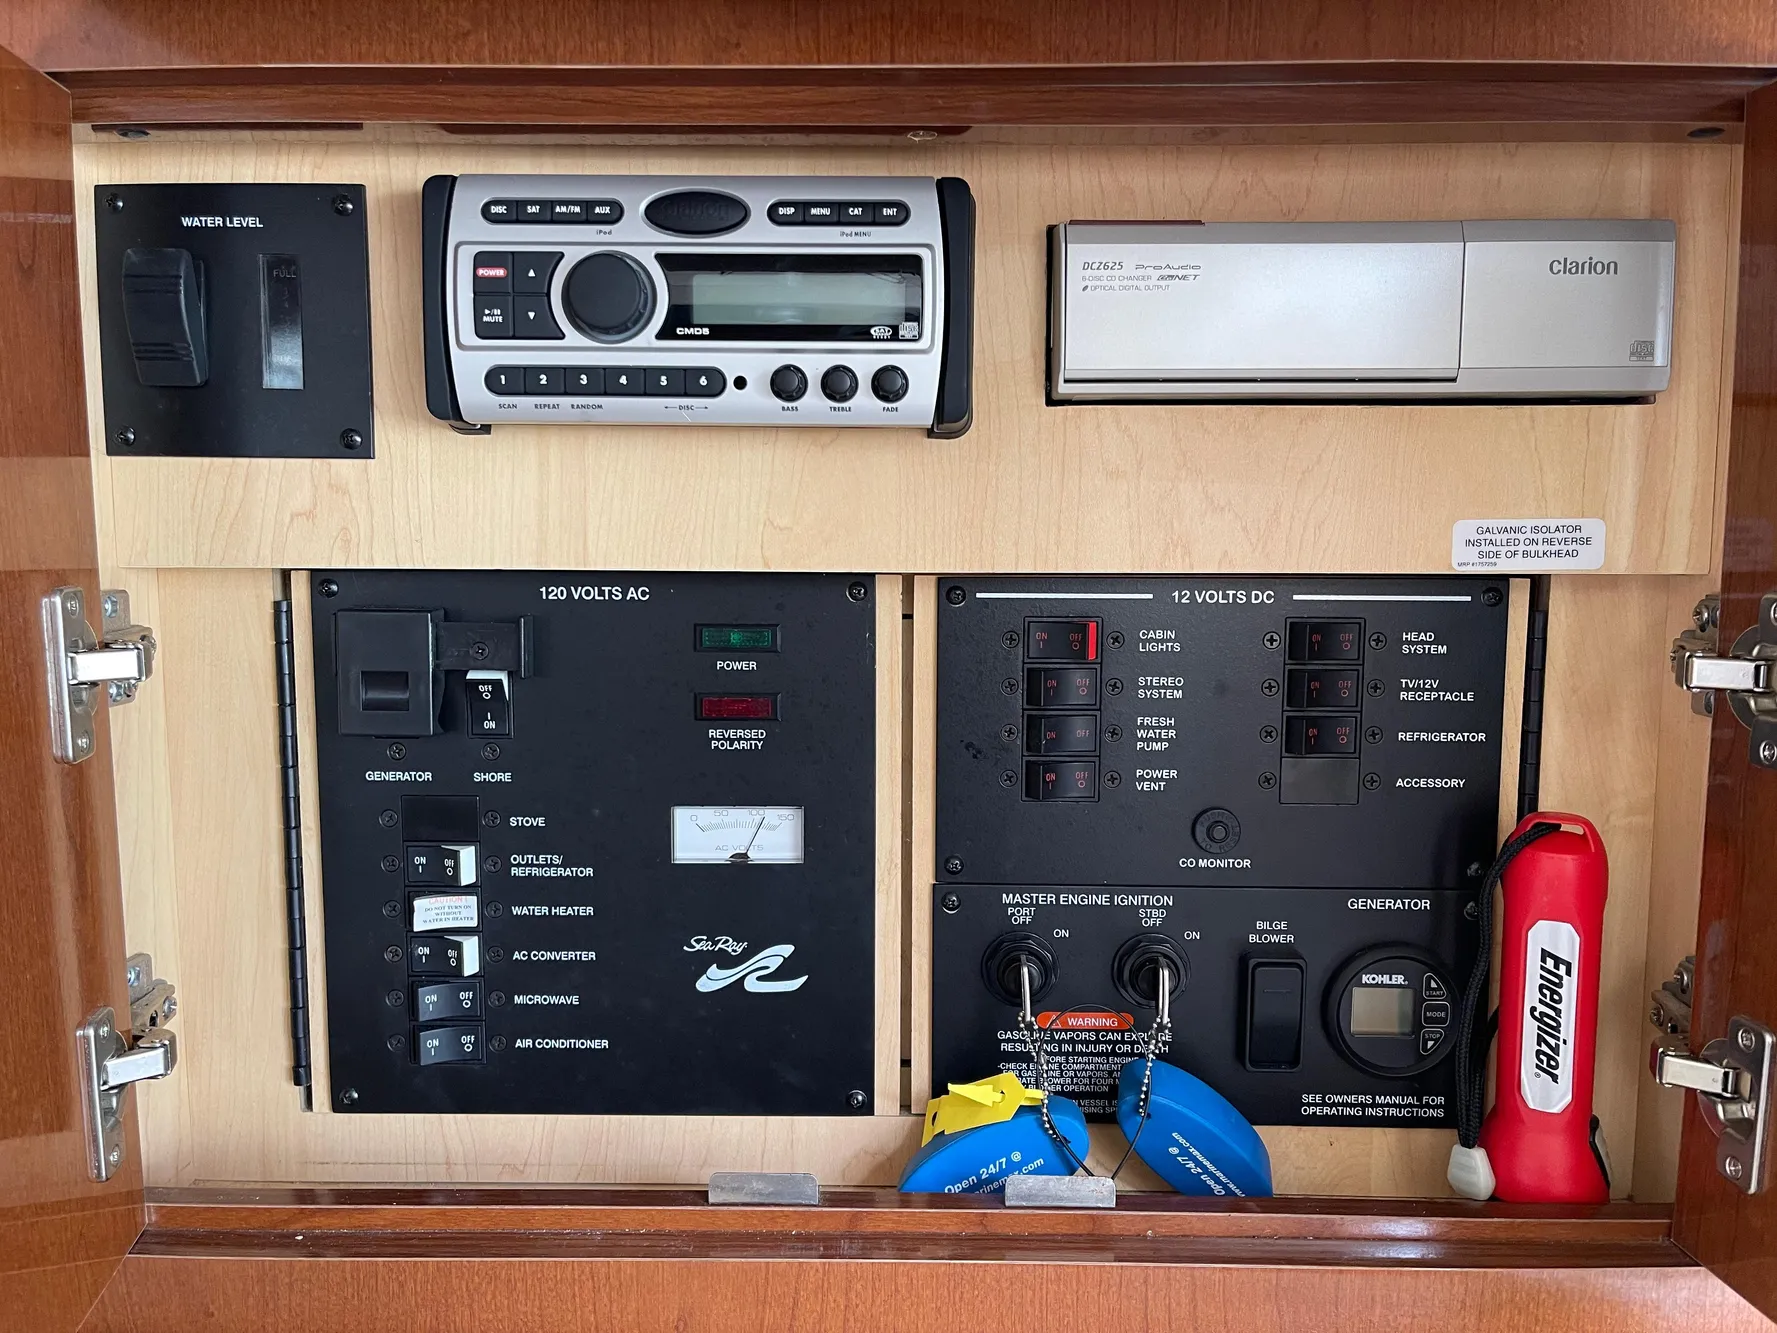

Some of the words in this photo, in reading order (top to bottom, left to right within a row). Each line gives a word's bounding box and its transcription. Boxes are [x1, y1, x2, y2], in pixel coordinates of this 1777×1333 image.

[491, 206, 507, 214] DISC
[527, 205, 540, 213] SAT
[555, 205, 581, 214] AM/FM
[595, 206, 610, 214] AUX
[778, 207, 795, 215] DISP
[810, 207, 831, 216] MENU
[849, 207, 863, 216] CAT
[883, 208, 897, 217] ENT
[181, 216, 223, 228] WATER
[226, 217, 264, 228] LEVEL
[1082, 261, 1124, 271] DCZ625
[273, 269, 297, 278] FULL
[483, 315, 503, 323] MUTE
[500, 375, 505, 384] 1
[539, 375, 548, 384] 2
[580, 374, 588, 385] 3
[619, 375, 628, 385] 4
[660, 376, 667, 385] 5
[699, 376, 708, 385] 6
[1476, 526, 1527, 535] GALVANIC
[1530, 525, 1582, 534] ISOLATOR
[1465, 538, 1520, 547] INSTALLED
[1524, 538, 1539, 546] ON
[1542, 537, 1592, 546] REVERSE
[1478, 550, 1501, 560] SIDE
[1505, 550, 1519, 559] OF
[1522, 549, 1579, 559] BULKHEAD
[539, 586, 567, 600] 120
[570, 586, 623, 600] VOLTS
[626, 586, 650, 601] AC
[1172, 591, 1197, 604] 12
[1199, 591, 1247, 604] VOLTS
[1251, 591, 1275, 604] DC
[1036, 632, 1048, 640] ON
[1069, 633, 1082, 641] OFF
[1139, 630, 1175, 640] CABIN
[1403, 632, 1435, 642] HEAD
[1139, 642, 1181, 652] LIGHTS
[1402, 645, 1447, 654] SYSTEM
[716, 661, 757, 670] POWER
[1138, 677, 1184, 687] STEREO
[1400, 679, 1439, 689] TV/12V
[1138, 690, 1183, 699] SYSTEM
[1400, 692, 1475, 702] RECEPTACLE
[484, 721, 496, 729] ON
[1137, 717, 1175, 727] FRESH
[708, 729, 766, 739] REVERSED
[1137, 730, 1176, 739] WATER
[1398, 732, 1486, 742] REFRIGERATOR
[711, 741, 763, 750] POLARITY
[1137, 742, 1169, 751] PUMP
[365, 771, 432, 782] GENERATOR
[473, 772, 512, 782] SHORE
[1136, 770, 1178, 779] POWER
[1136, 782, 1166, 791] VENT
[1395, 779, 1465, 788] ACCESSORY
[509, 817, 546, 827] STOVE
[414, 857, 426, 865] ON
[444, 859, 454, 868] OFF
[511, 855, 564, 865] OUTLETS/
[1179, 859, 1196, 868] CO
[1198, 859, 1251, 868] MONITOR
[511, 867, 594, 877] REFRIGERATOR
[1002, 894, 1056, 904] MASTER
[1060, 895, 1110, 905] ENGINE
[1114, 895, 1173, 906] IGNITION
[1347, 899, 1430, 910] GENERATOR
[512, 906, 549, 916] WATER
[552, 906, 594, 916] HEATER
[1008, 908, 1036, 916] PORT
[1139, 909, 1166, 917] STBD
[1011, 916, 1032, 925] OFF
[1142, 918, 1162, 927] OFF
[1256, 921, 1288, 930] BILGE
[1053, 929, 1069, 938] ON
[1184, 931, 1200, 940] ON
[1249, 934, 1294, 943] BLOWER
[683, 935, 715, 952] Sea
[513, 951, 529, 961] AC
[530, 951, 596, 961] CONVERTER
[514, 995, 580, 1005] MICROWAVE
[1529, 947, 1572, 1084] Energizer
[1067, 1017, 1118, 1027] WARNING
[1053, 1031, 1096, 1040] VAPORS
[1099, 1032, 1122, 1040] CAN
[1124, 1033, 1172, 1041] EXPLDE
[515, 1039, 533, 1048] AIR
[535, 1039, 609, 1049] CONDITIONER
[1062, 1044, 1074, 1052] IN
[1076, 1044, 1112, 1053] INJURY
[1116, 1044, 1130, 1053] OR
[1301, 1094, 1322, 1103] SEE
[1325, 1095, 1372, 1104] OWNERS
[1375, 1096, 1420, 1105] MANUAL
[1422, 1096, 1445, 1105] FOR
[1301, 1107, 1362, 1116] OPERATING
[1365, 1108, 1444, 1118] INSTRUCTIONS
[1168, 1147, 1179, 1155] @
[1176, 1156, 1203, 1174] 24/7
[944, 1175, 977, 1194] Open
[980, 1157, 1007, 1180] 24/7
[1011, 1151, 1022, 1162] @
[1200, 1174, 1225, 1195] Open
